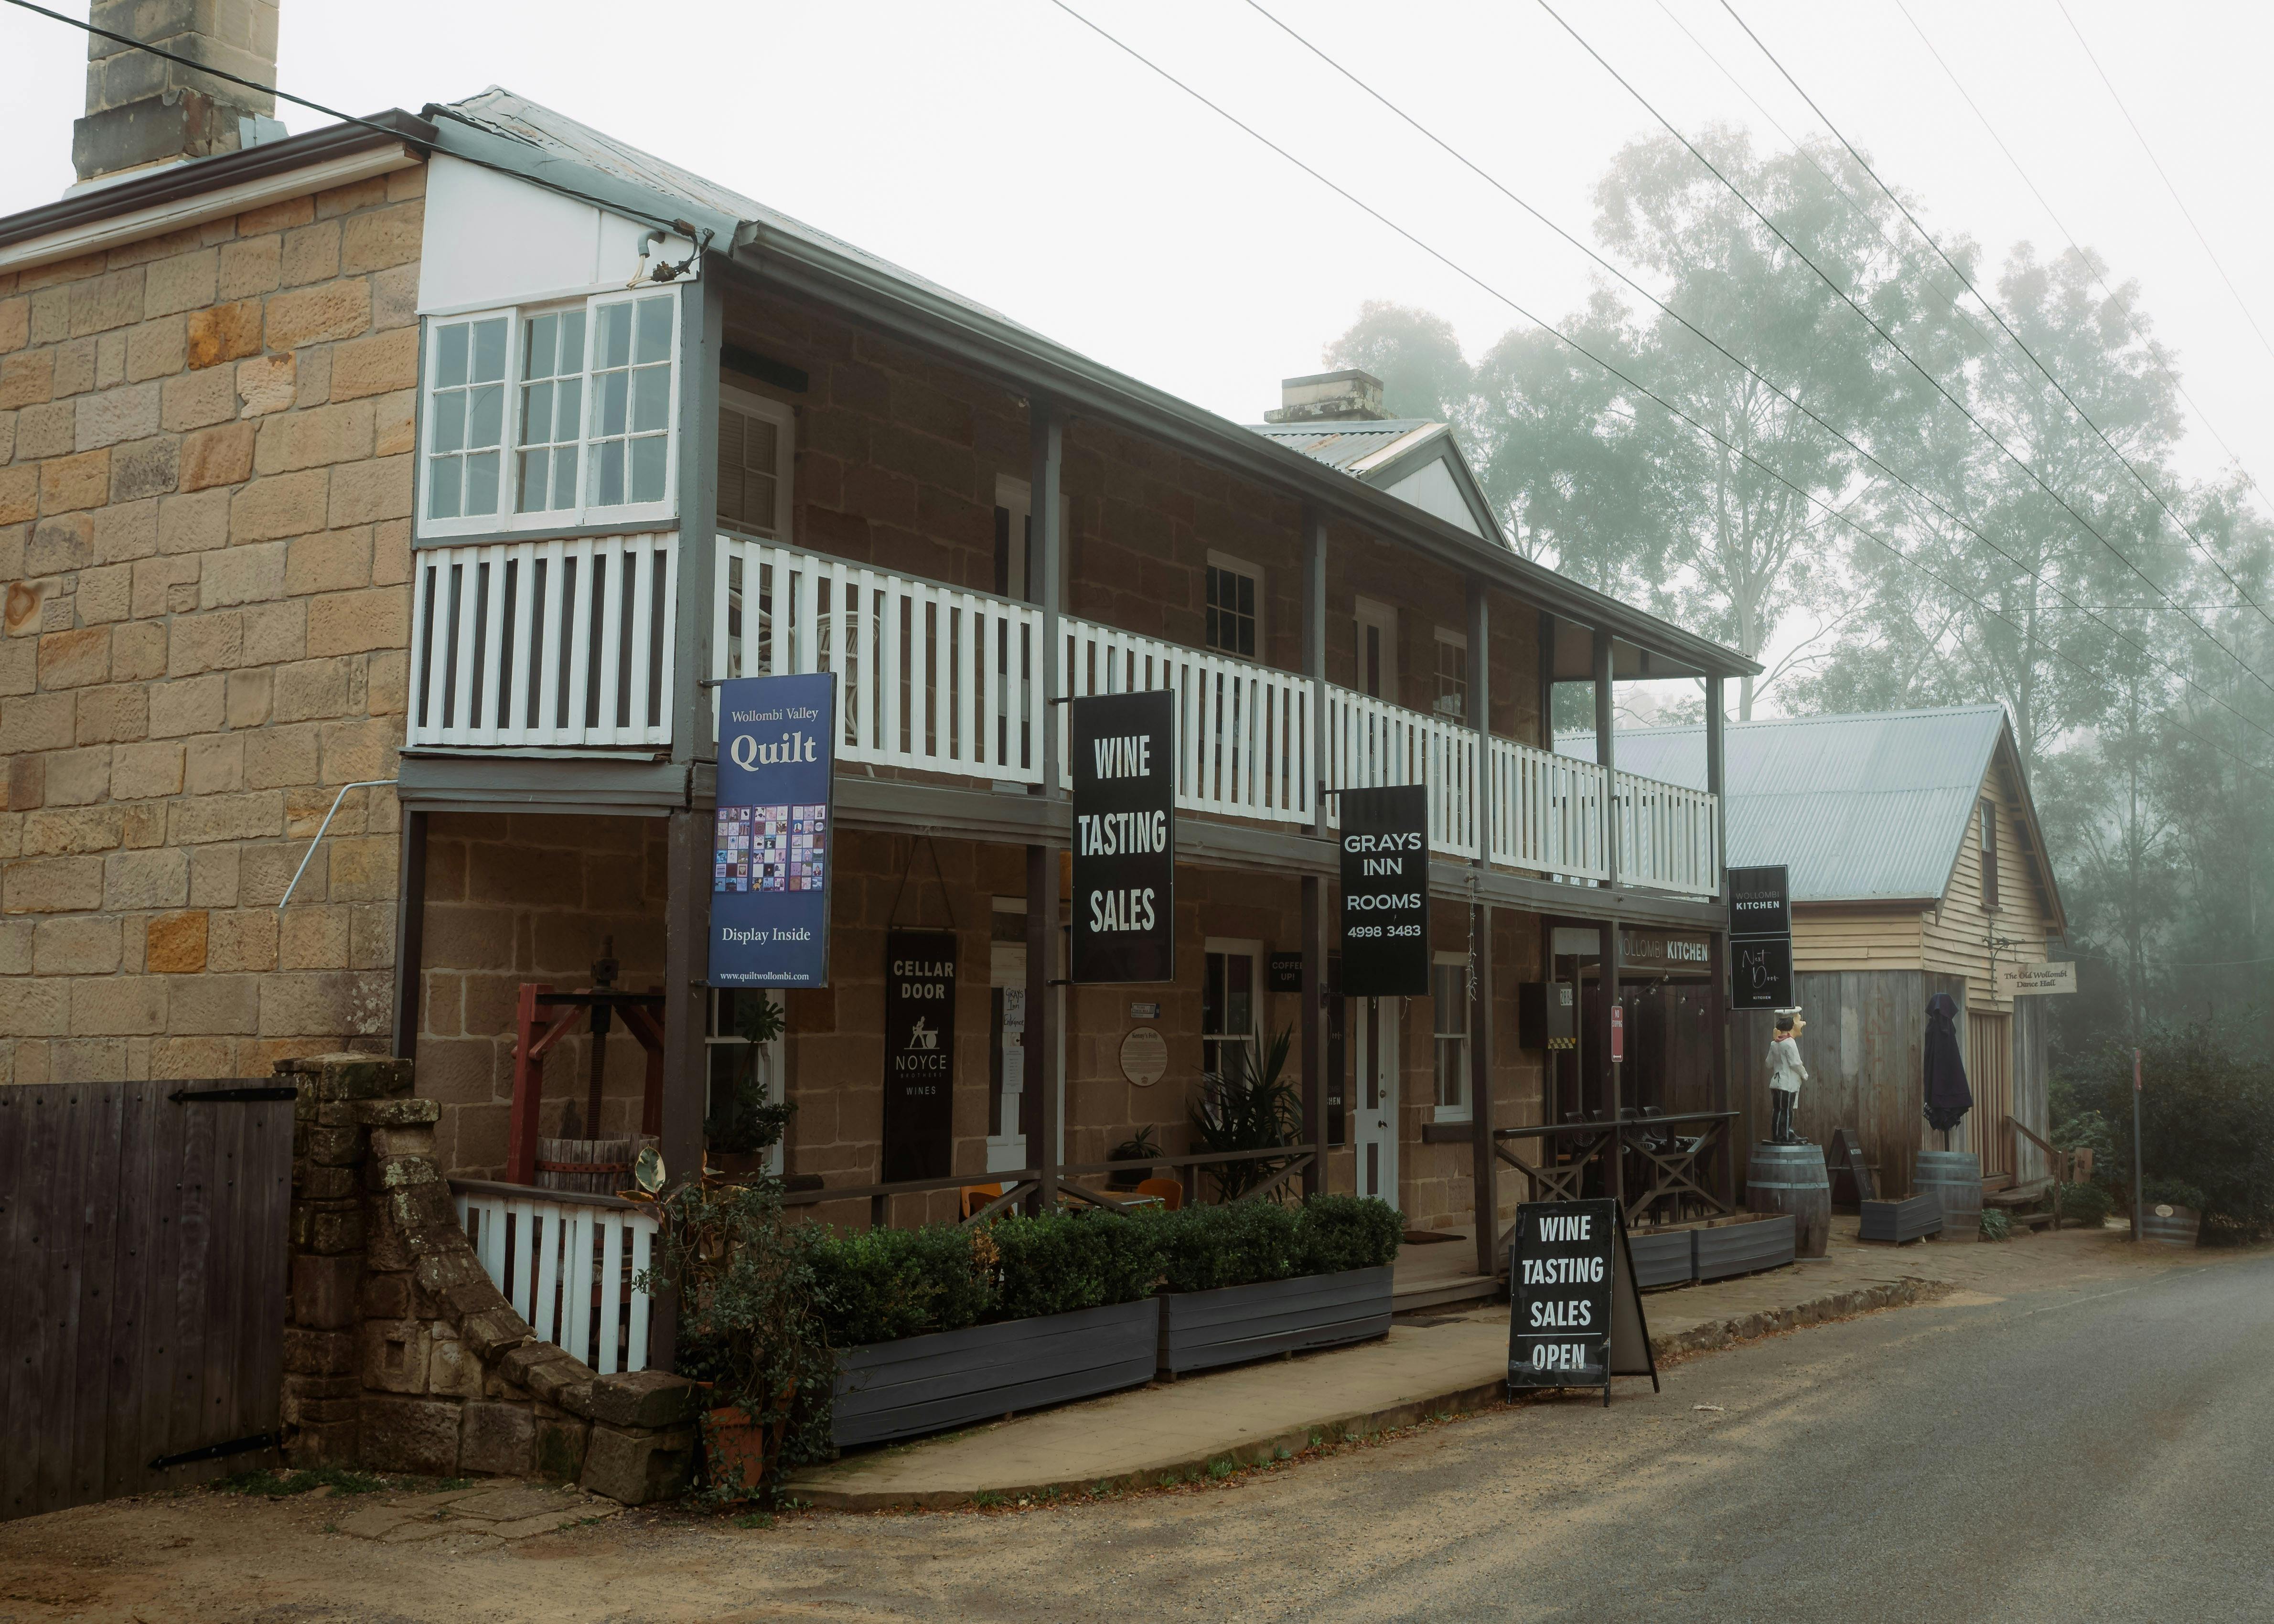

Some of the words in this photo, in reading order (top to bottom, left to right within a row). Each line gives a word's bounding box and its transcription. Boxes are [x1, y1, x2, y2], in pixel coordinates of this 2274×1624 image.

[731, 708, 783, 723] Wollombi
[786, 706, 819, 722] Valley
[730, 731, 817, 772] Quilt
[1094, 735, 1150, 779] WINE
[1078, 810, 1166, 856] TASTING
[1344, 832, 1422, 853] GRAYS
[1363, 857, 1403, 876] INN
[1347, 893, 1421, 910] ROOMS
[1735, 890, 1780, 900] WOLLOMBI
[1090, 887, 1155, 932] SALES
[1736, 900, 1780, 910] KITCHEN
[722, 928, 769, 945] Display
[772, 927, 811, 940] Inside
[1348, 926, 1382, 938] 4998
[1387, 925, 1421, 937] 3483
[1667, 940, 1708, 962] KITCHEN
[1742, 944, 1771, 968] Next
[720, 972, 809, 982] www.quiltwollombi.com
[894, 960, 954, 977] CELLAR
[2033, 970, 2068, 978] Wollombi
[902, 983, 944, 999] DOOR
[896, 1055, 946, 1070] NOYCE
[906, 1086, 936, 1095] WINES
[1539, 1215, 1591, 1242] WINE
[1522, 1257, 1604, 1284] TASTING
[1530, 1300, 1591, 1327] SALES
[1533, 1344, 1585, 1370] OPEN
